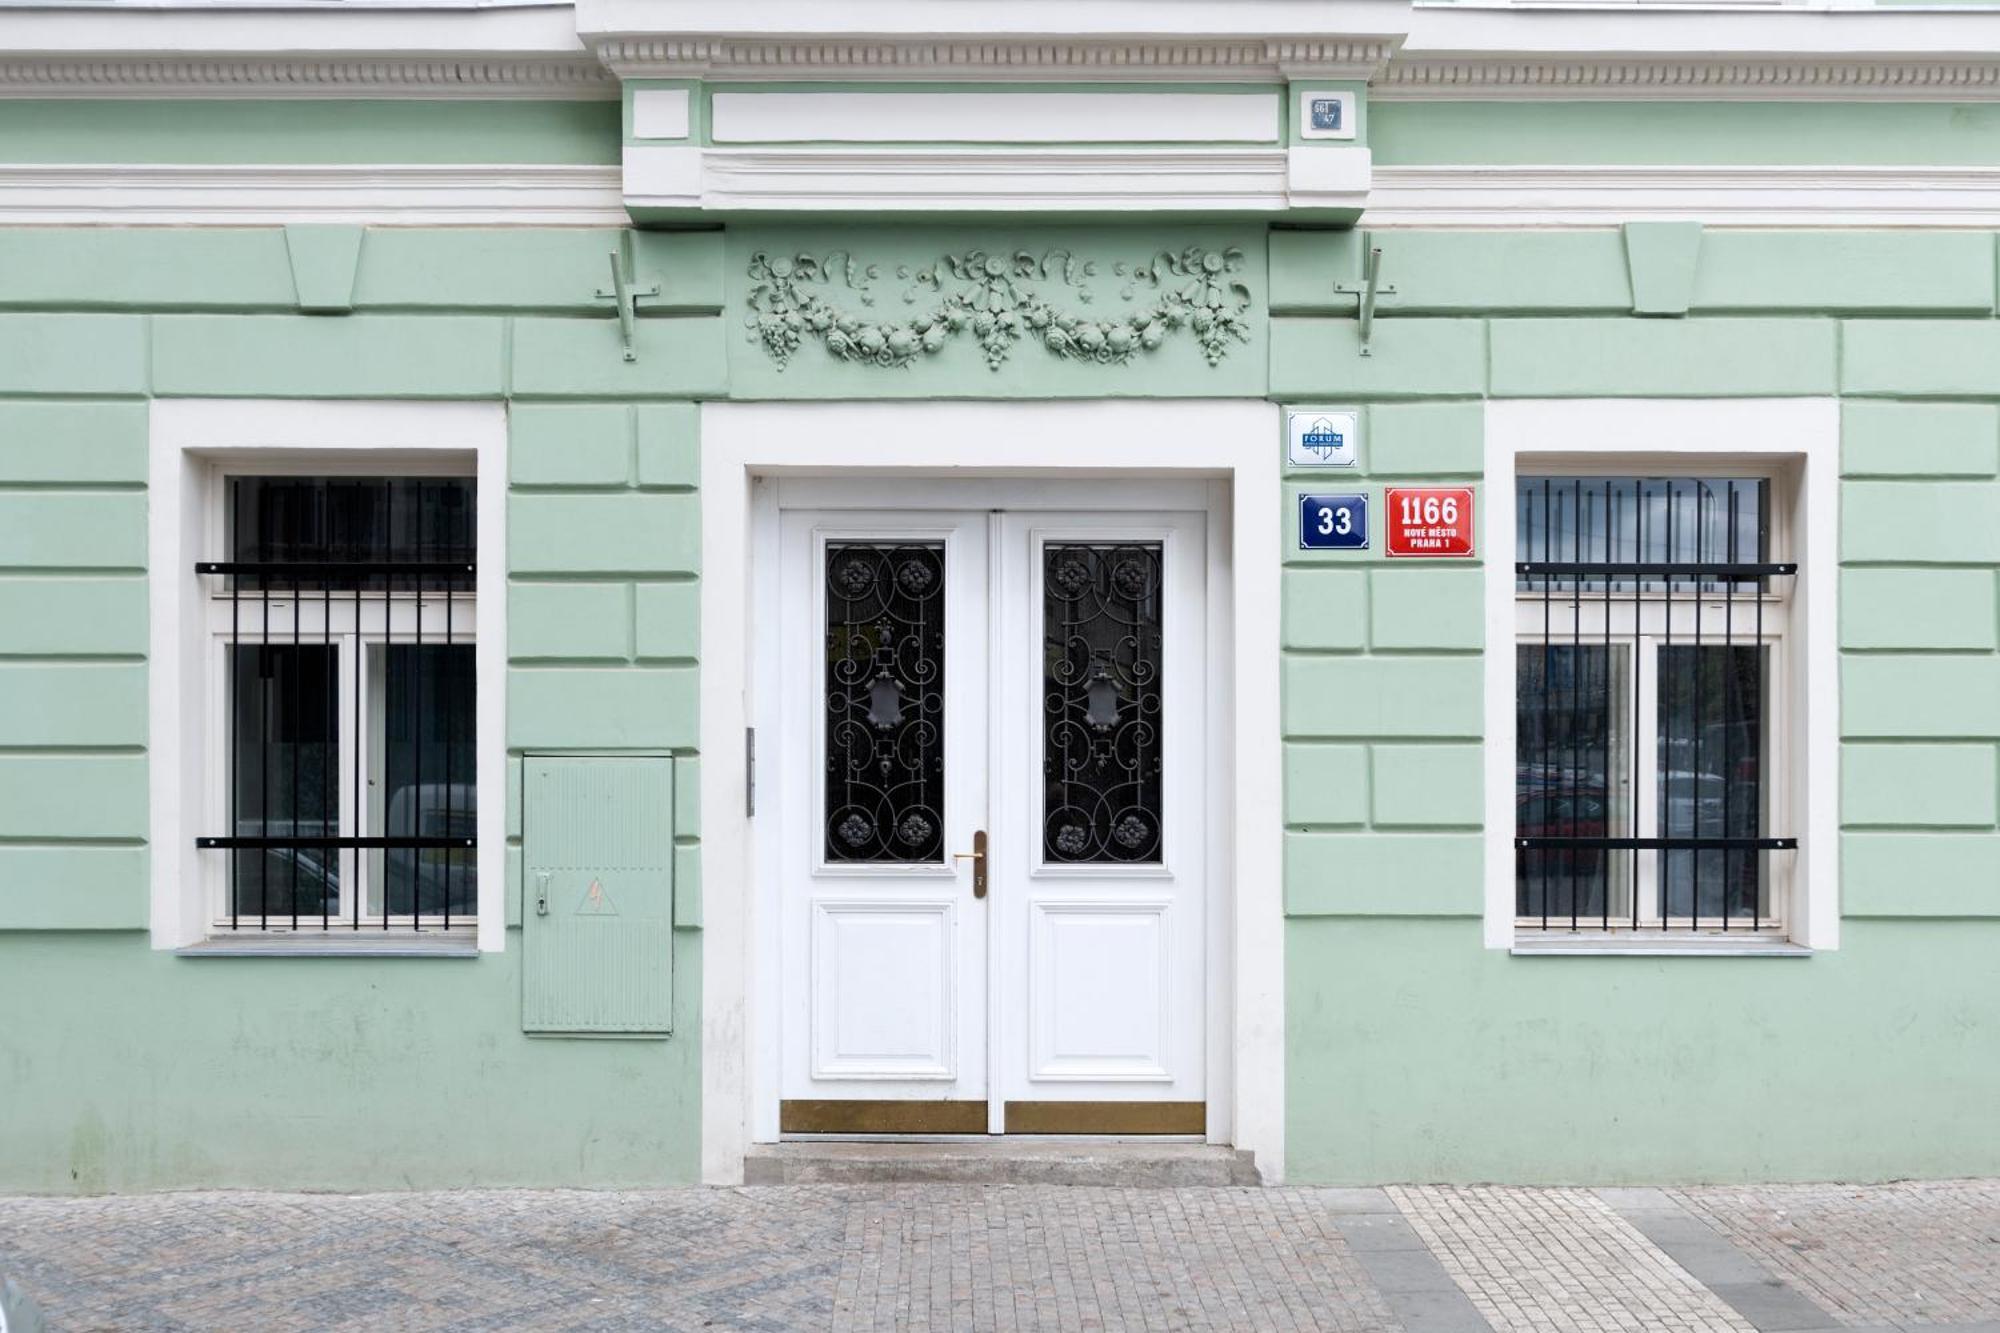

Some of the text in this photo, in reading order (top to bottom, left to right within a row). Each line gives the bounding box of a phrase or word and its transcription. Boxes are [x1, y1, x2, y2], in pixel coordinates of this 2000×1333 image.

[1401, 497, 1458, 525] 1166
[1318, 507, 1351, 535] 33
[1403, 526, 1457, 537] NOVÉ MĚSTO
[1410, 539, 1450, 548] PRAHA 1
